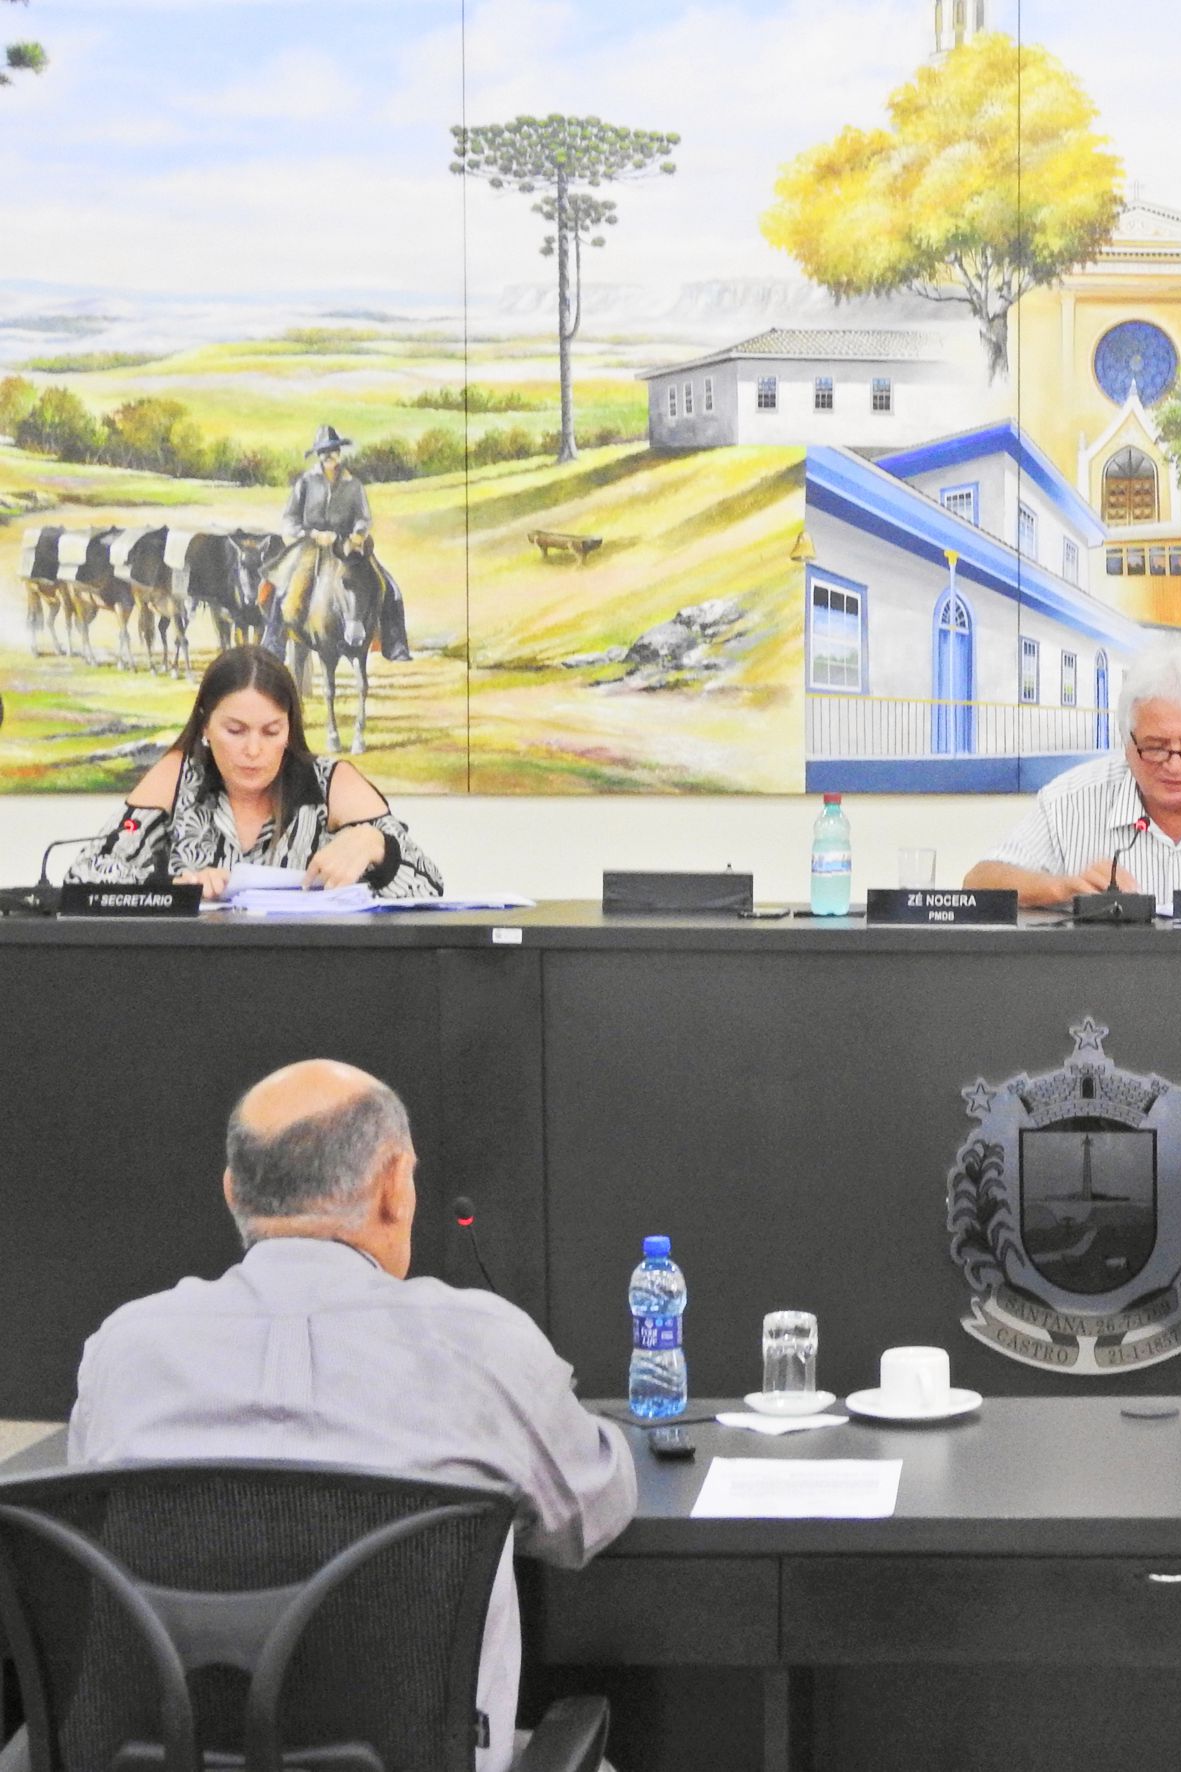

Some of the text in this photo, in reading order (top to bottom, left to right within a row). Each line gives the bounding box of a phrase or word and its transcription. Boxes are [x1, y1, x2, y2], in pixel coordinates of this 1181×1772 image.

[100, 891, 173, 908] SECRETÁRIO
[907, 892, 977, 907] ZÉ NOCERA
[928, 910, 955, 922] PMDB
[996, 1327, 1070, 1364] CASTRO
